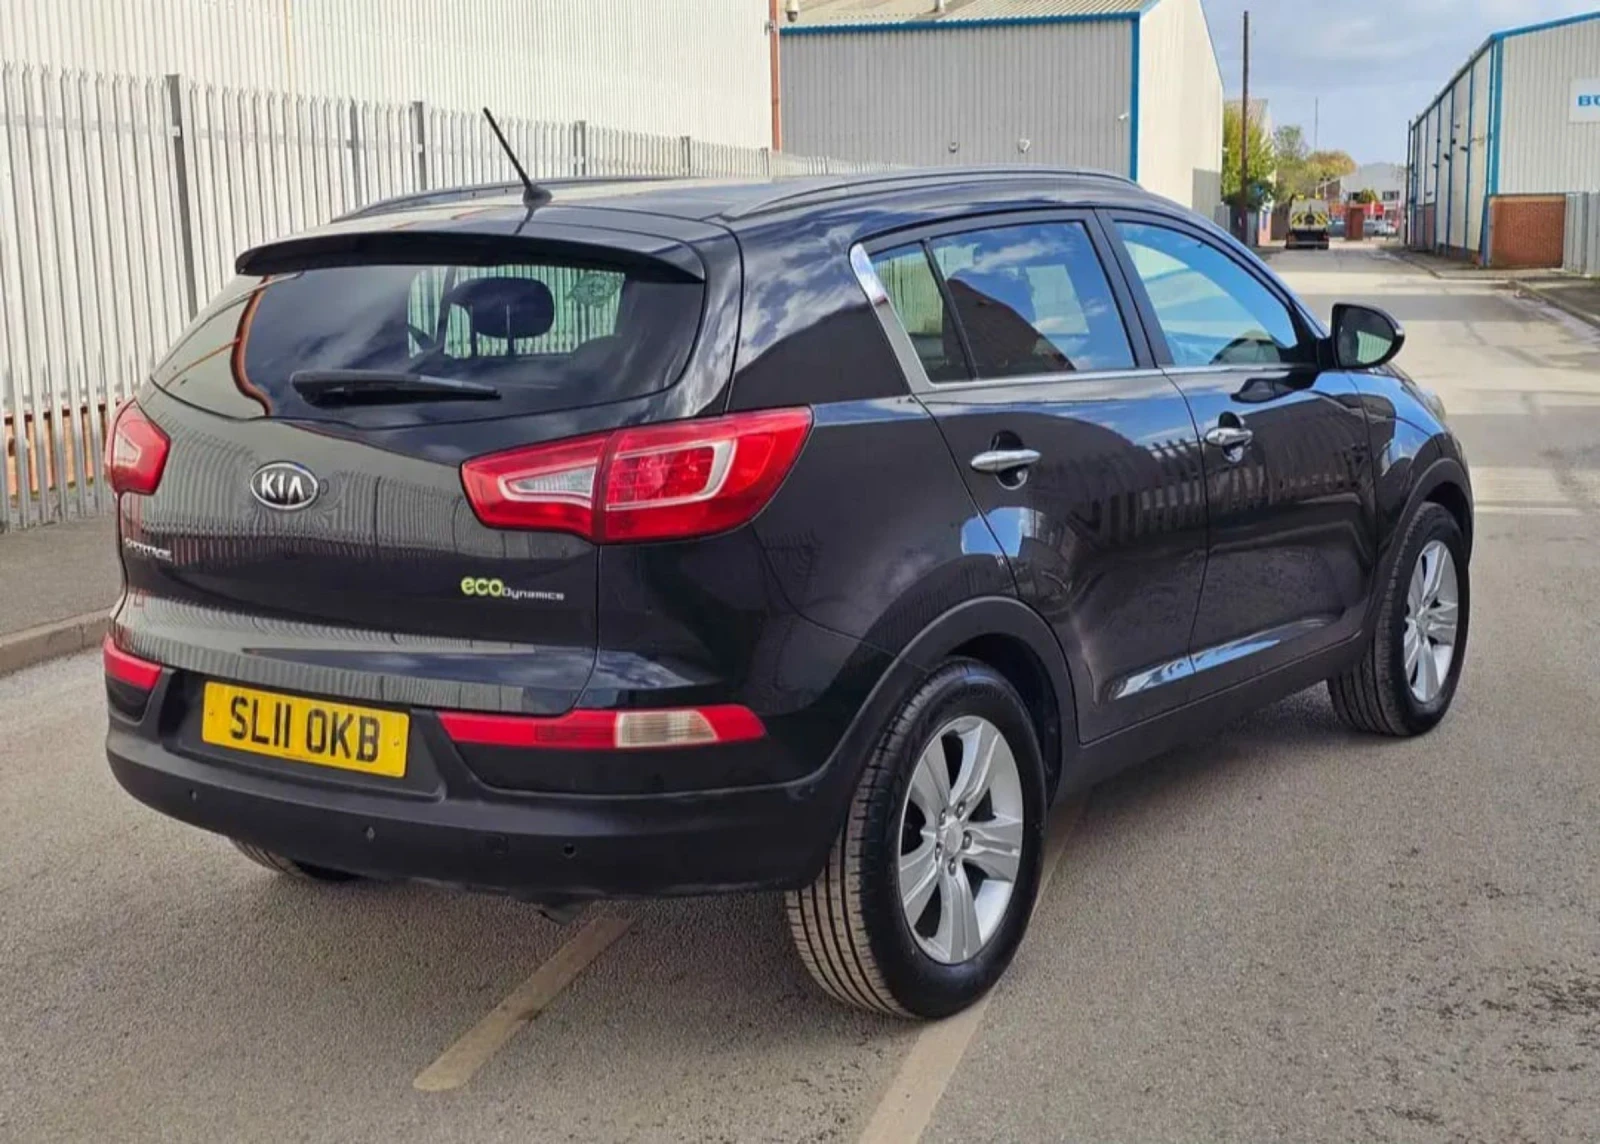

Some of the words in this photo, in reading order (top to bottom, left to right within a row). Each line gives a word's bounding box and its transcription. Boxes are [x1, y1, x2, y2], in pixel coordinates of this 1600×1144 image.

[261, 472, 305, 504] KIA
[230, 695, 292, 749] SL11
[306, 708, 381, 763] OKB
